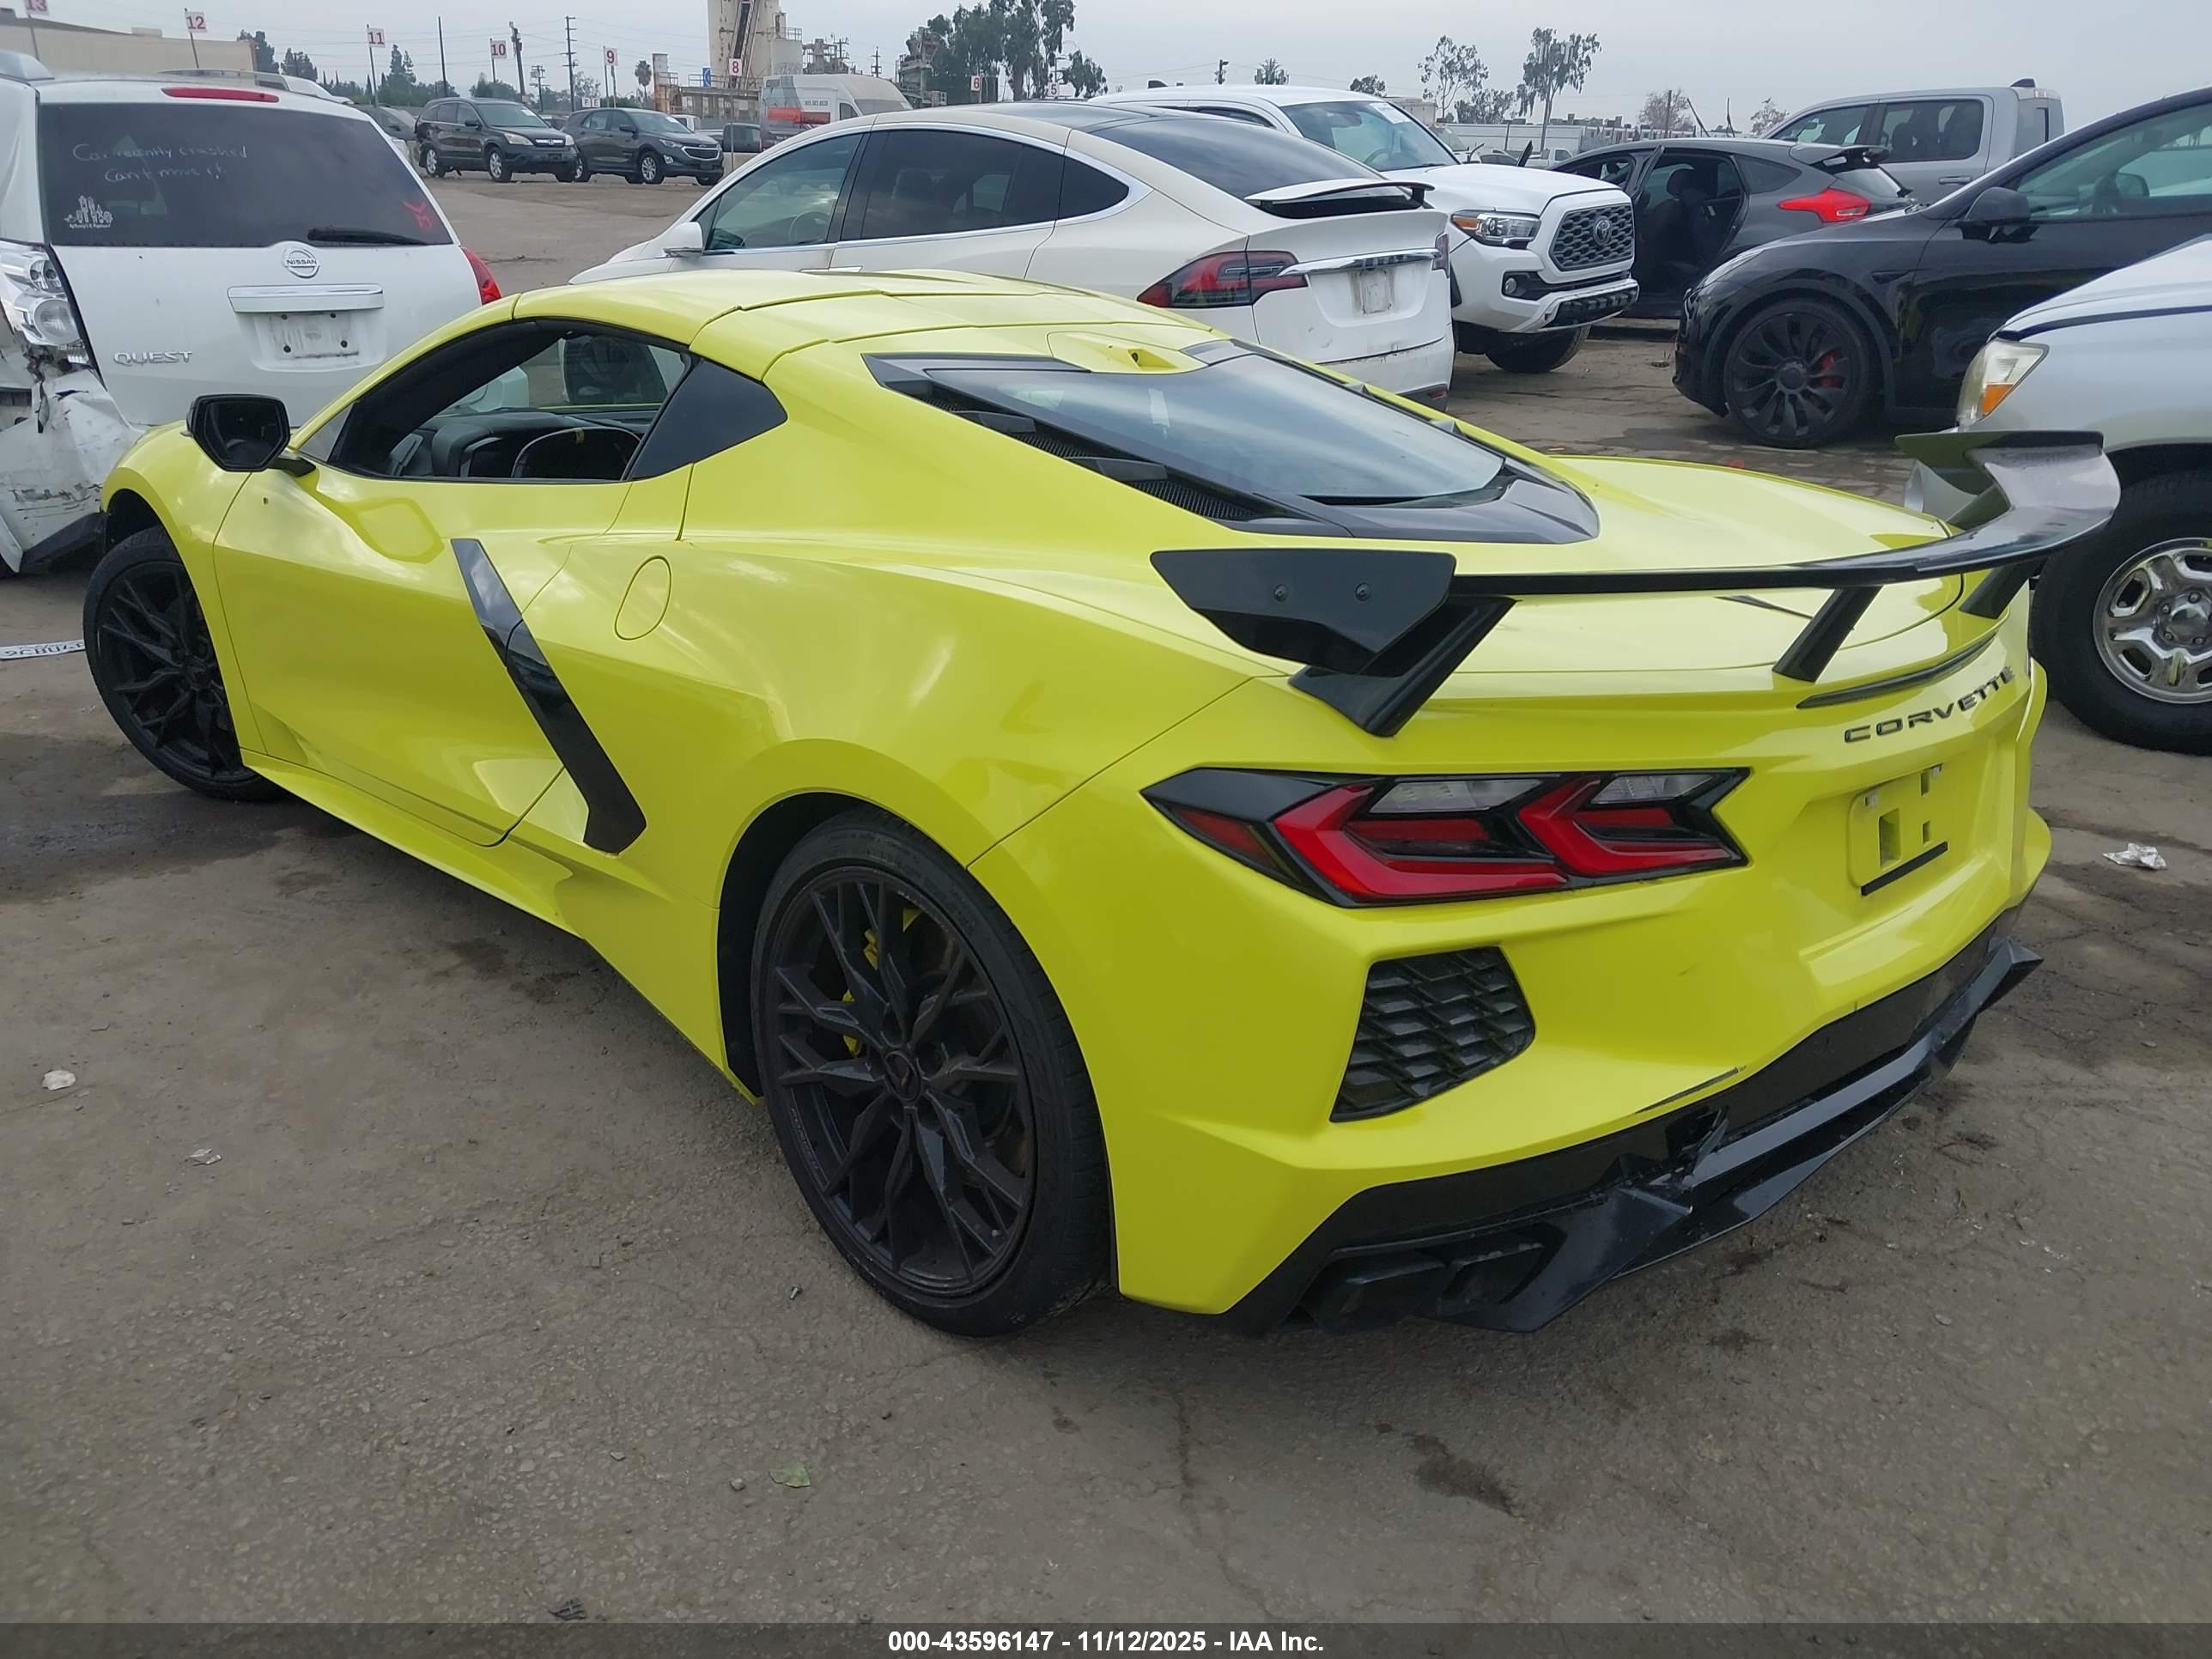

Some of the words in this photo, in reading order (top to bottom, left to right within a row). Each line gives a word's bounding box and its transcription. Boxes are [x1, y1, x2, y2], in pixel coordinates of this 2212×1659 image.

[186, 15, 207, 30] 12
[368, 32, 386, 46] 11
[490, 44, 507, 56] 10
[606, 50, 615, 64] 9
[732, 61, 739, 74] 8
[973, 77, 980, 89] 6
[1050, 84, 1058, 95] 5
[113, 351, 193, 367] QUEST
[1844, 666, 2014, 744] CORVETTE
